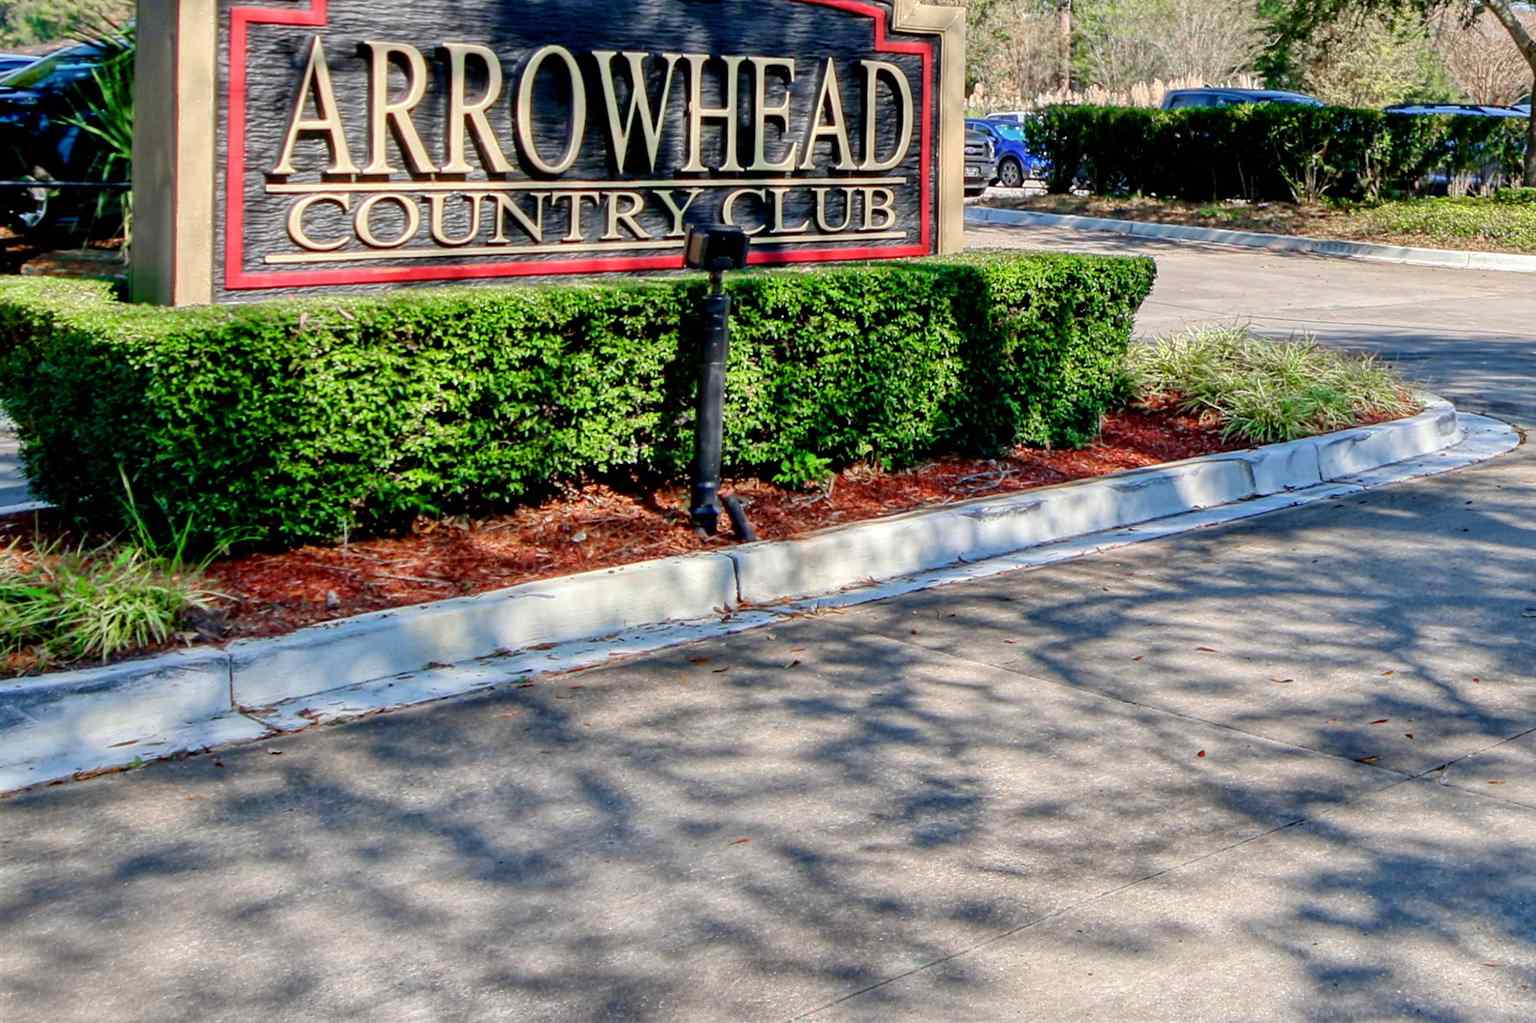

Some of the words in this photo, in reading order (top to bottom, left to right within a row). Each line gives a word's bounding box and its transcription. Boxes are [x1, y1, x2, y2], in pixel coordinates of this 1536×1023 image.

[271, 35, 914, 175] ARROWHEAD
[287, 188, 705, 251] COUNTRY
[721, 186, 897, 235] CLUB
